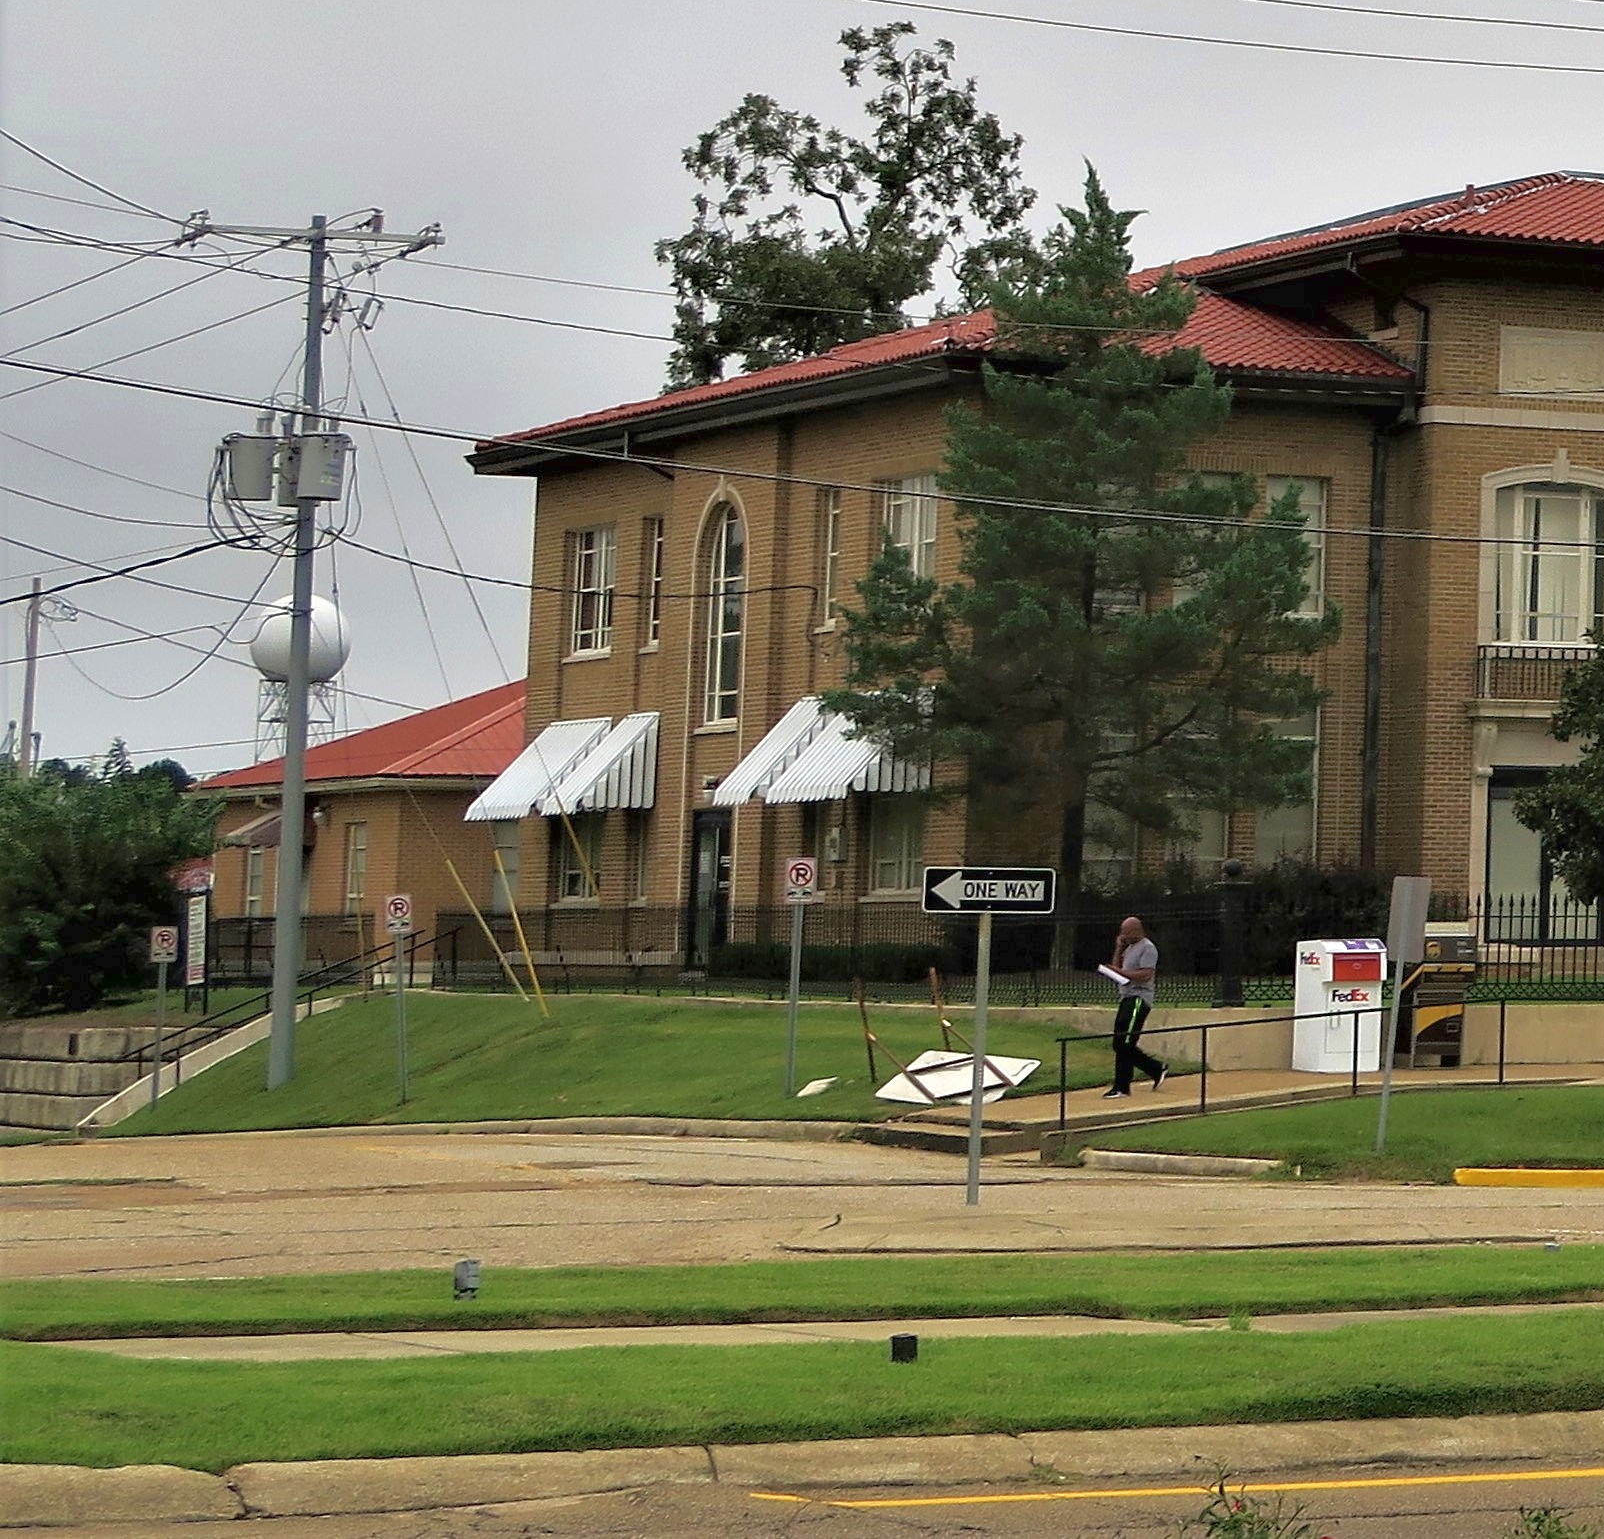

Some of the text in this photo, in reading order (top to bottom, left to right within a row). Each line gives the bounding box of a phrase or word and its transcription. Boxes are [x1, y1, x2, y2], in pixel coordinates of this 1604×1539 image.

[963, 882, 1040, 899] ONE WAY
[1332, 988, 1370, 1003] FedEx
